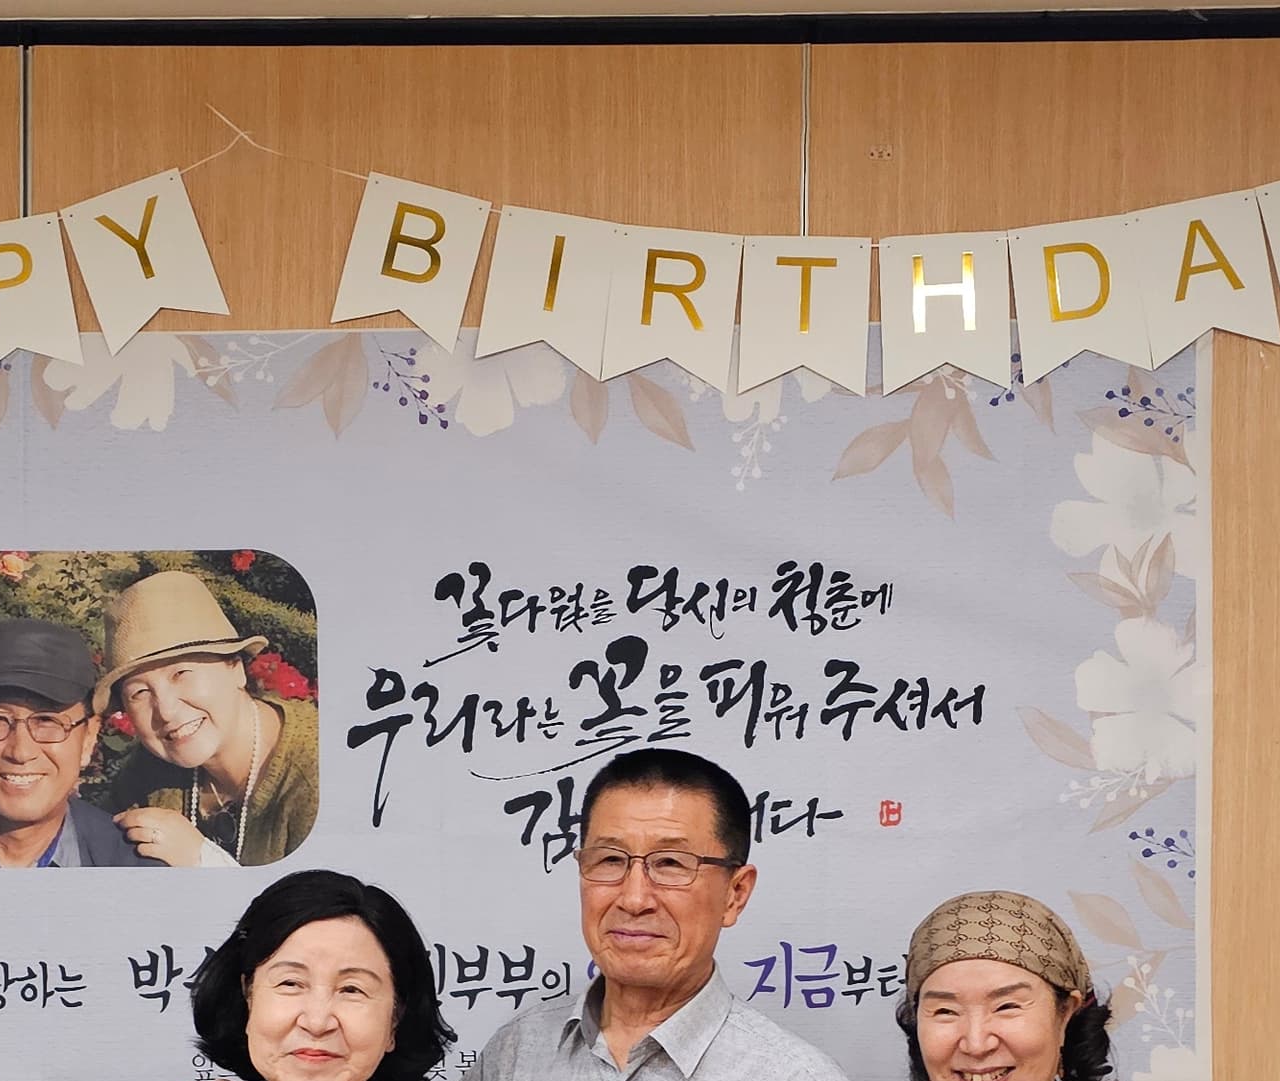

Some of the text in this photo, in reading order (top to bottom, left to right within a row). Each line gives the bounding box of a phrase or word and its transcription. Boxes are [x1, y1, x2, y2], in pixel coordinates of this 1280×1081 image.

[626, 564, 757, 640] 당신의
[768, 560, 893, 636] 청춘에
[347, 666, 566, 828] 우리라는
[699, 656, 808, 748] 피워
[820, 658, 986, 741] 주셔서
